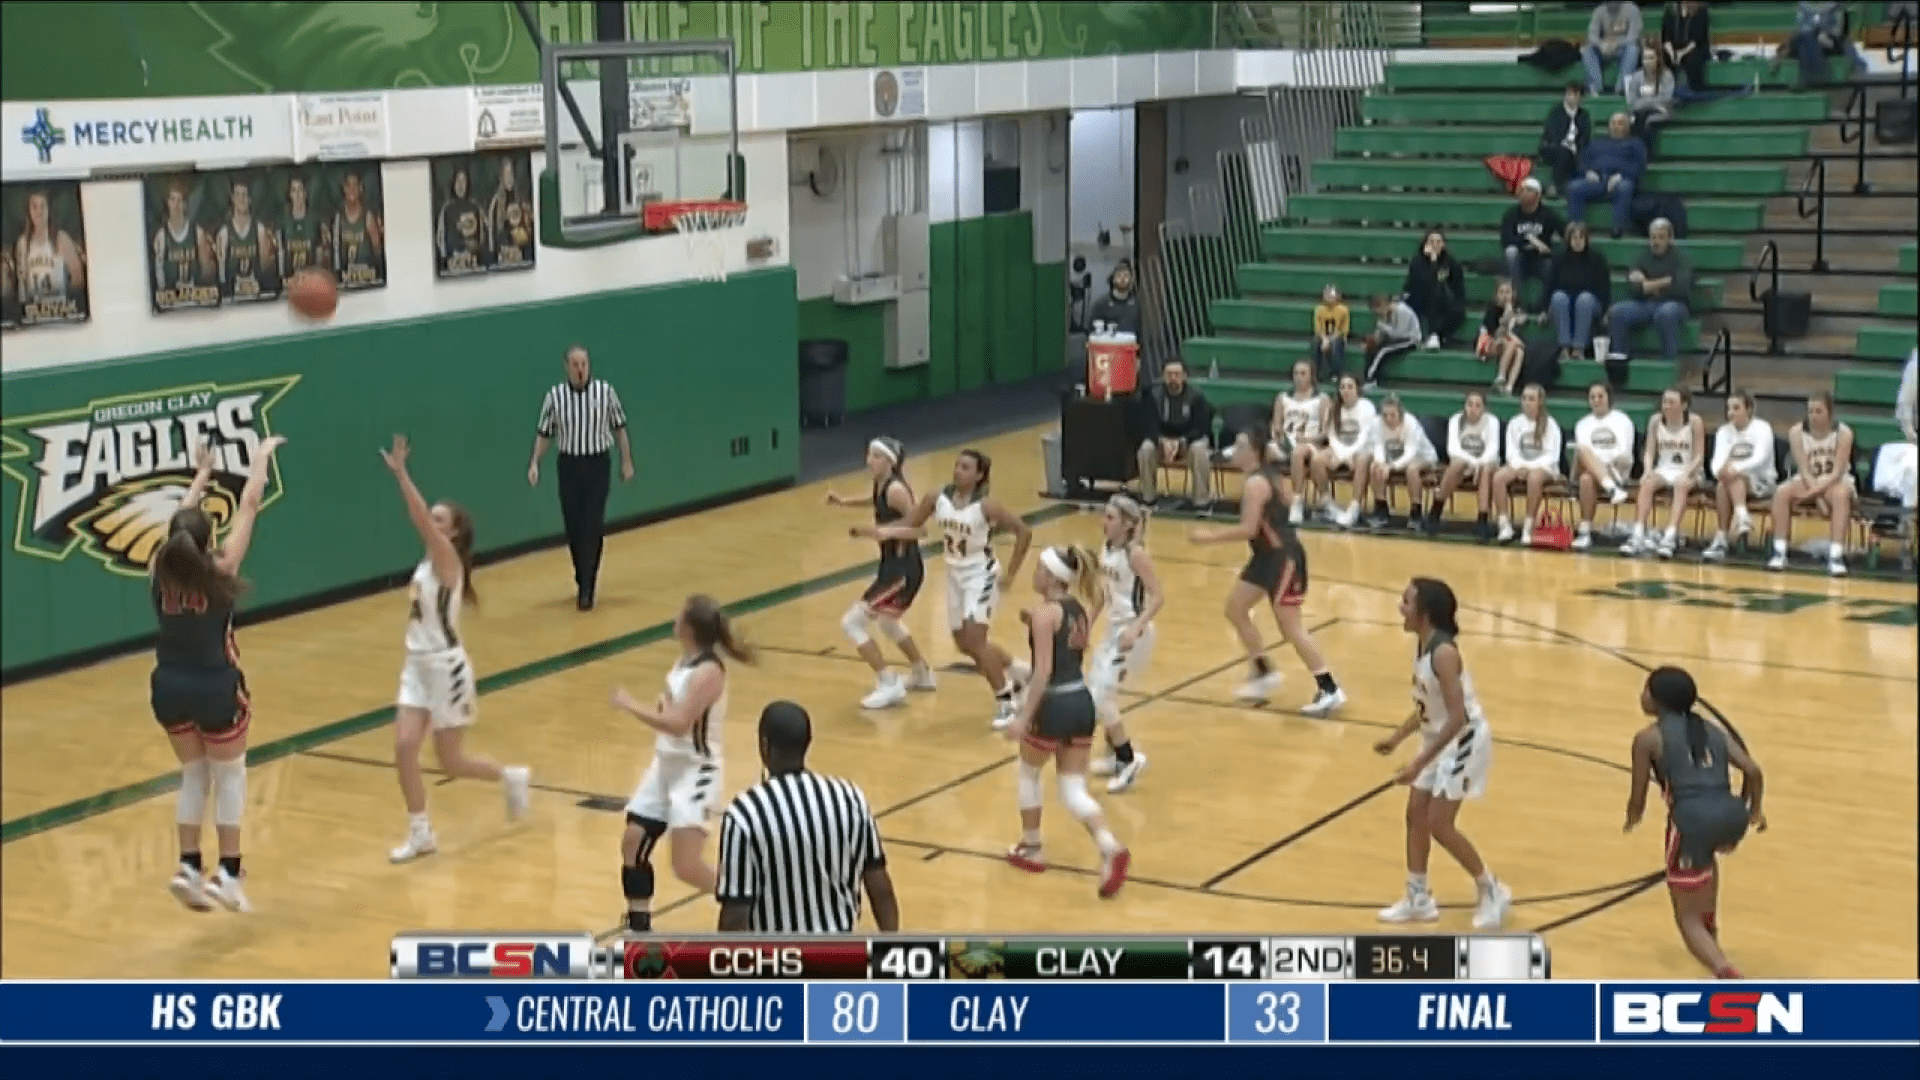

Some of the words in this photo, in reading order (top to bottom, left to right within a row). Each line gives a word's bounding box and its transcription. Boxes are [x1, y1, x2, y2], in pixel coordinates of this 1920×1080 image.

[900, 3, 1043, 62] EAGLES
[95, 401, 164, 423] OREGON
[167, 391, 213, 410] CLAY
[28, 392, 263, 533] EAGLES
